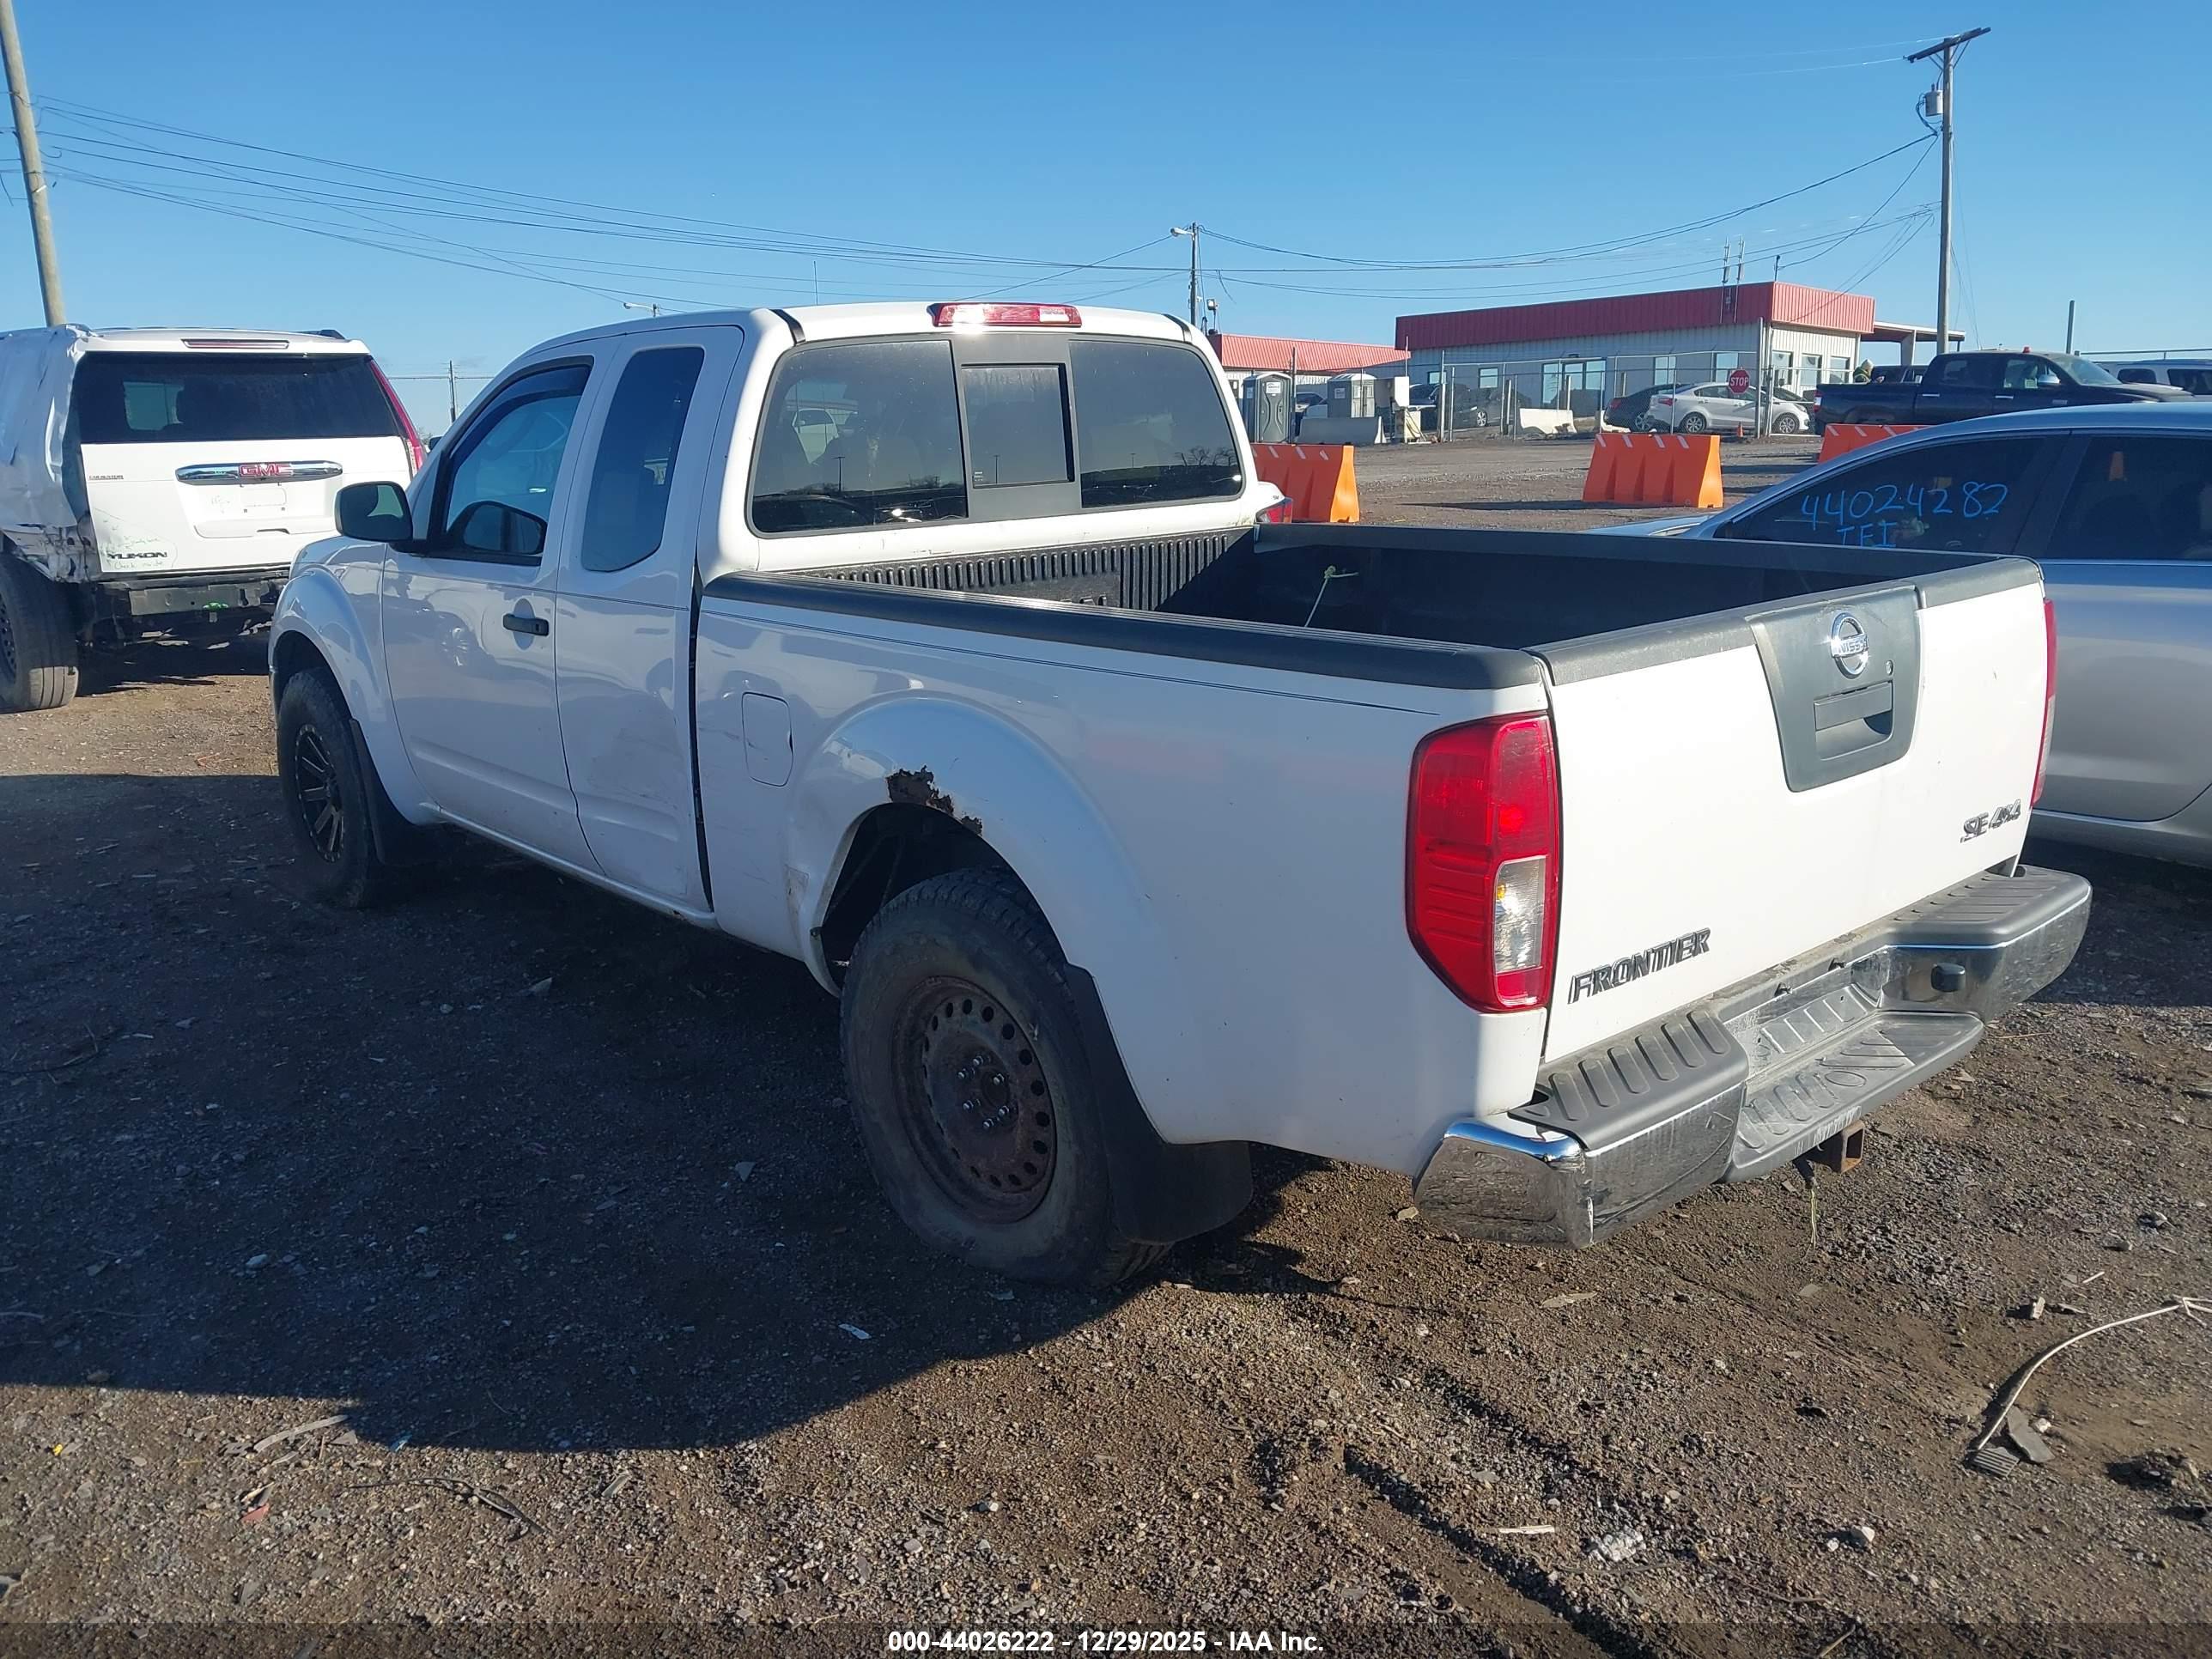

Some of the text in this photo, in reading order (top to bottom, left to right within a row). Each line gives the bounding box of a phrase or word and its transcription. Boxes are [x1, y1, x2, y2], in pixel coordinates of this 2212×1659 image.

[1730, 376, 1749, 386] STOP
[239, 463, 293, 477] GMC
[1801, 481, 2008, 531] 44024282
[106, 551, 167, 560] YUKON
[1960, 811, 1989, 843] SE
[1567, 927, 1711, 1005] FRONTIER
